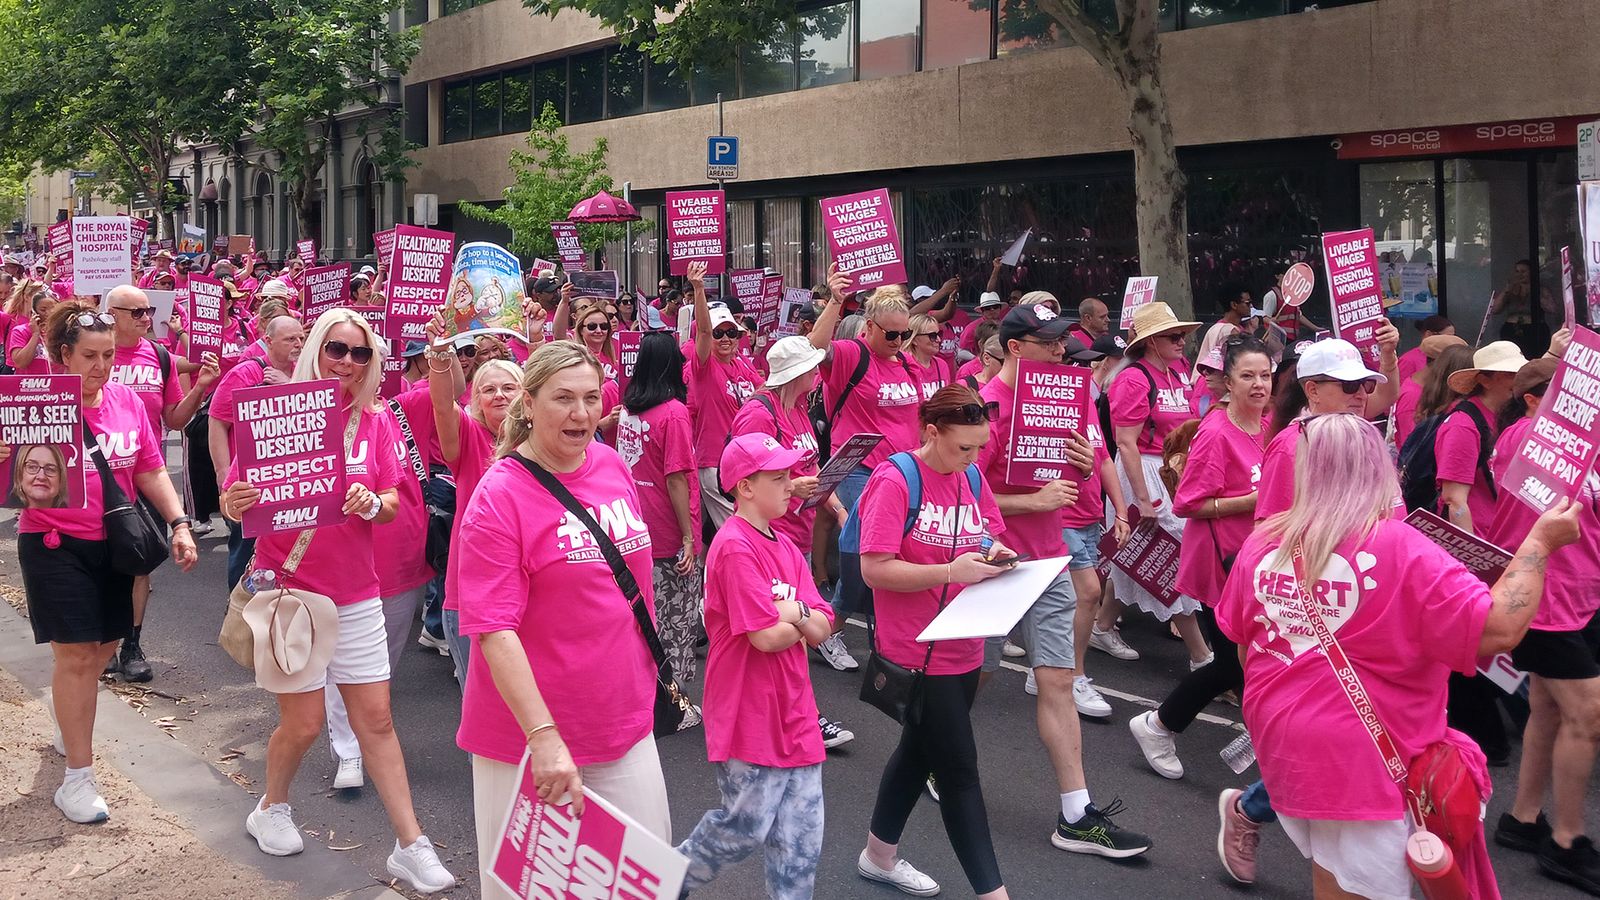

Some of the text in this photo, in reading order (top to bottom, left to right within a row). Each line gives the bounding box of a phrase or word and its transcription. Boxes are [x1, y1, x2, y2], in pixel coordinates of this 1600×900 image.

[1370, 130, 1440, 148] space
[1476, 122, 1556, 140] space
[1523, 134, 1556, 143] hotel
[1580, 128, 1592, 142] 2P
[716, 142, 730, 161] P
[1412, 141, 1441, 150] hotel
[672, 196, 718, 208] LIVEABLE
[828, 196, 882, 216] LIVEABLE
[678, 206, 714, 216] WAGES
[836, 208, 878, 224] WAGES
[76, 224, 94, 232] THE
[97, 223, 128, 232] ROYAL
[672, 218, 720, 228] ESSENTIAL
[674, 226, 718, 236] WORKERS
[832, 220, 888, 238] ESSENTIAL
[76, 233, 128, 242] CHILDRENS
[398, 234, 451, 254] HEALTHCARE
[556, 236, 580, 248] HEART
[836, 229, 888, 247] WORKERS
[80, 244, 124, 252] HOSPITAL
[837, 252, 854, 262] 3.75%
[854, 250, 865, 260] PAY
[866, 246, 882, 258] OFFER
[1329, 238, 1370, 258] LIVEABLE
[402, 251, 444, 268] WORKERS
[838, 250, 896, 272] SLAP IN THE FACE!
[1335, 251, 1366, 268] WAGES
[306, 267, 348, 286] HEALTHCARE
[402, 266, 441, 284] DESERVE
[732, 273, 764, 284] HEALTHCARE
[860, 270, 883, 282] HWU
[1284, 268, 1312, 299] STOP
[1333, 266, 1374, 286] ESSENTIAL
[191, 280, 223, 298] HEALTHCARE
[310, 278, 344, 295] WORKERS
[393, 286, 446, 300] RESPECT
[736, 280, 760, 290] WORKERS
[738, 288, 760, 296] DESERVE
[1132, 278, 1152, 292] HWU
[1336, 278, 1374, 296] WORKERS
[195, 294, 220, 308] WORKERS
[312, 288, 342, 304] DESERVE
[197, 306, 220, 320] DESERVE
[391, 302, 419, 316] FAIR
[192, 322, 222, 334] RESPECT
[192, 335, 222, 348] FAIR PAY
[20, 378, 52, 388] HWU
[110, 366, 164, 386] HWU
[1025, 372, 1083, 388] LIVEABLE
[14, 392, 74, 405] announcing the
[1032, 386, 1075, 400] WAGES
[238, 388, 336, 422] HEALTHCARE
[1022, 404, 1081, 418] ESSENTIAL
[1552, 390, 1599, 432] DESERVE
[29, 406, 78, 424] & SEEK
[394, 406, 413, 440] MONA
[1024, 416, 1078, 430] WORKERS
[250, 410, 326, 440] WORKERS
[3, 425, 73, 444] CHAMPION
[1018, 436, 1049, 446] 3.75% PAY
[1534, 416, 1592, 460] RESPECT
[256, 431, 324, 460] DESERVE
[1016, 446, 1060, 459] SLAP IN THE
[246, 455, 336, 483] RESPECT
[409, 446, 428, 480] MONA
[1522, 440, 1582, 486] FAIR PAY
[1033, 468, 1062, 478] HWU
[257, 476, 336, 504] AIR PAY
[1522, 476, 1556, 505] HWU
[272, 506, 319, 525] HWU
[915, 502, 983, 536] HWU
[912, 531, 941, 544] HEALTH
[568, 550, 598, 560] HEALTH
[1137, 538, 1168, 578] WORKERS
[1142, 542, 1176, 582] ESSENTIAL
[1266, 596, 1282, 607] FOR
[1298, 579, 1335, 652] SPORTSGIRL
[1338, 667, 1385, 742] SPORTSGIRL
